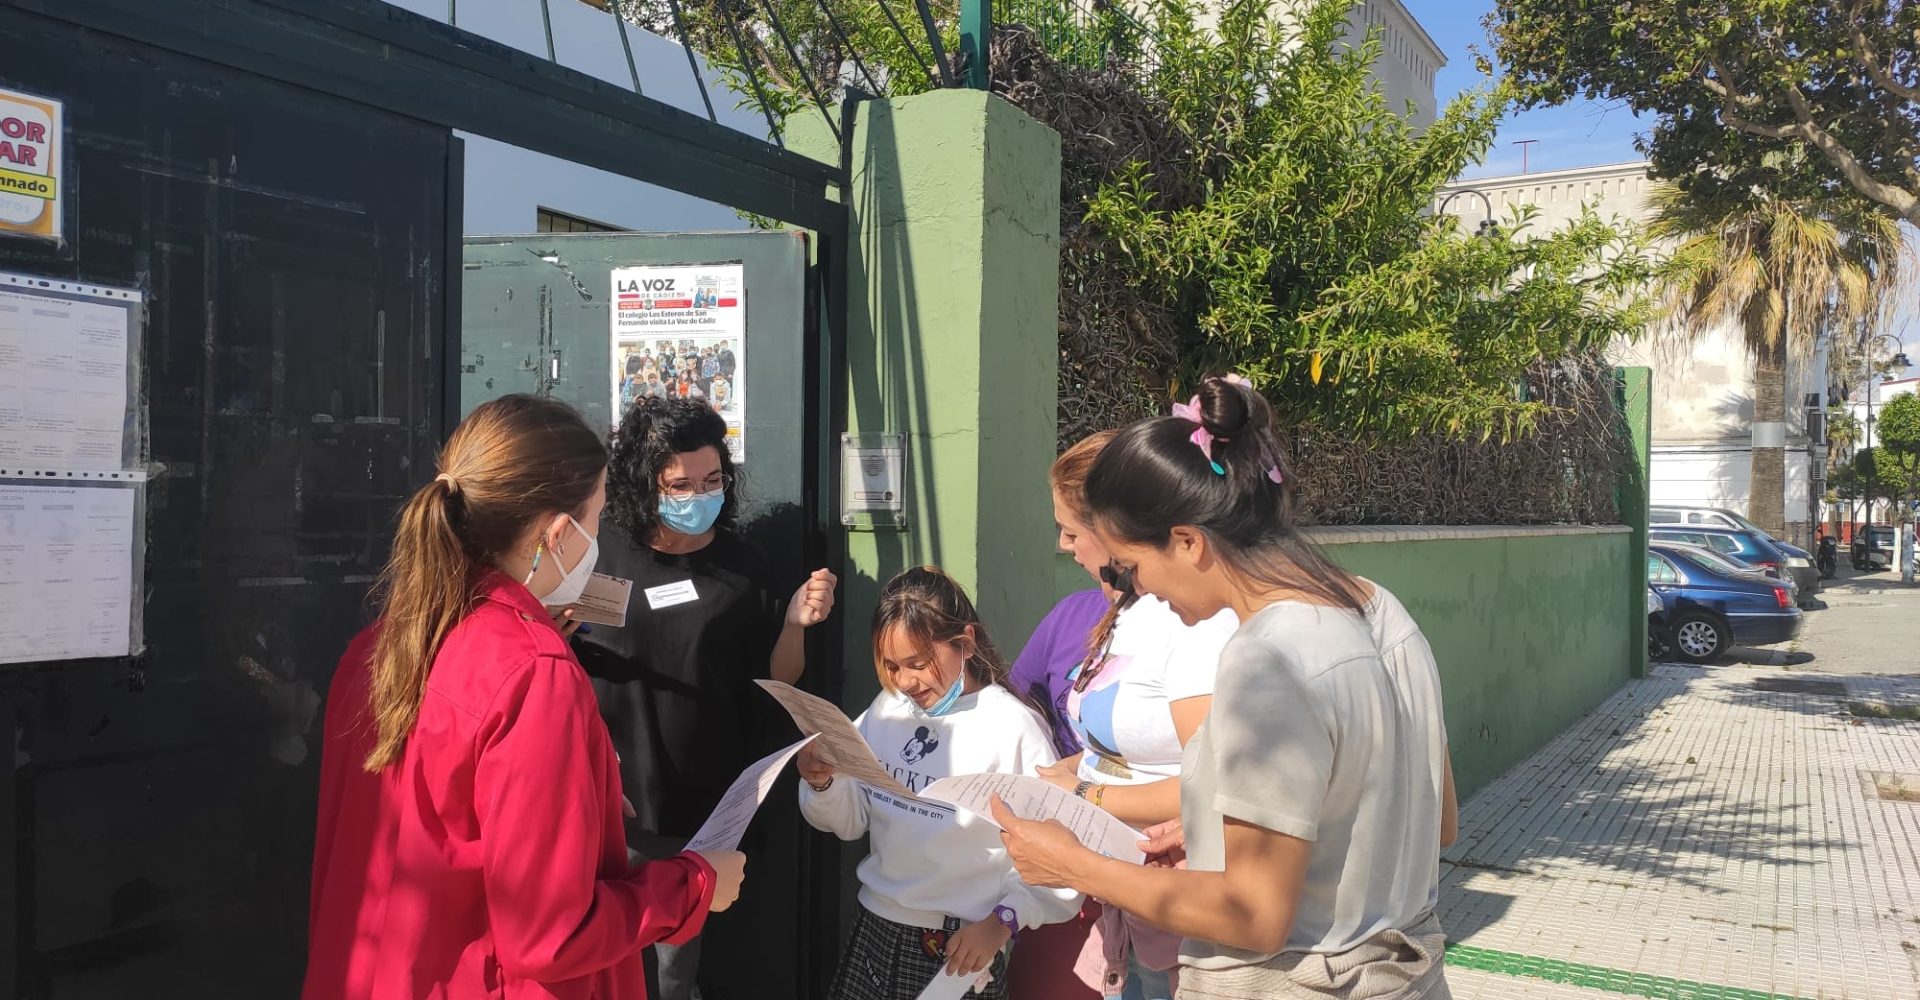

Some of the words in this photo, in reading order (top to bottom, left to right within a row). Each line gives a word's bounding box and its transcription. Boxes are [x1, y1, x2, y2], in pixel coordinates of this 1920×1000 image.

[0, 117, 45, 144] OR
[618, 280, 639, 292] LA
[642, 279, 675, 291] VOZ
[625, 311, 648, 319] colegio
[661, 310, 684, 318] Esteros
[910, 805, 916, 813] IN
[918, 808, 928, 816] THE
[931, 811, 944, 819] CITY
